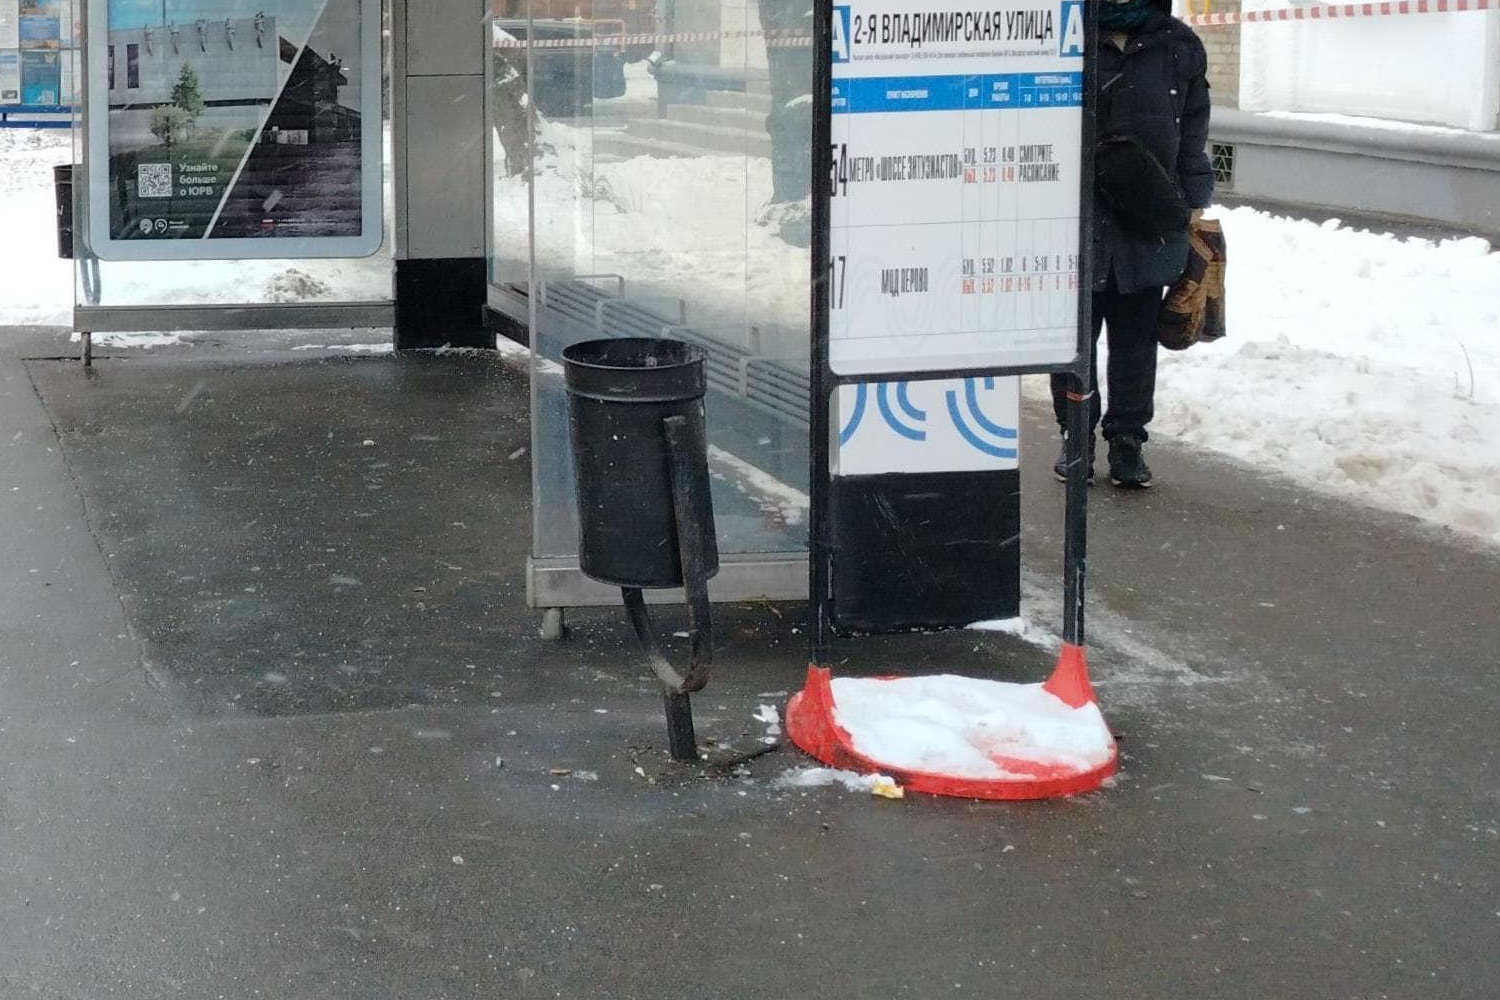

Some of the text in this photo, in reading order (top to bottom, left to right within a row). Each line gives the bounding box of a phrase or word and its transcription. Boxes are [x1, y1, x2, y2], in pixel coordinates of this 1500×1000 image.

[853, 9, 1054, 49] 2-Я ВЛАДИМИРСКАЯ УЛИЦА
[179, 162, 218, 173] Узнайте
[850, 156, 874, 182] МЕТРО
[179, 174, 217, 185] больше
[180, 187, 213, 196] о ЮРВ
